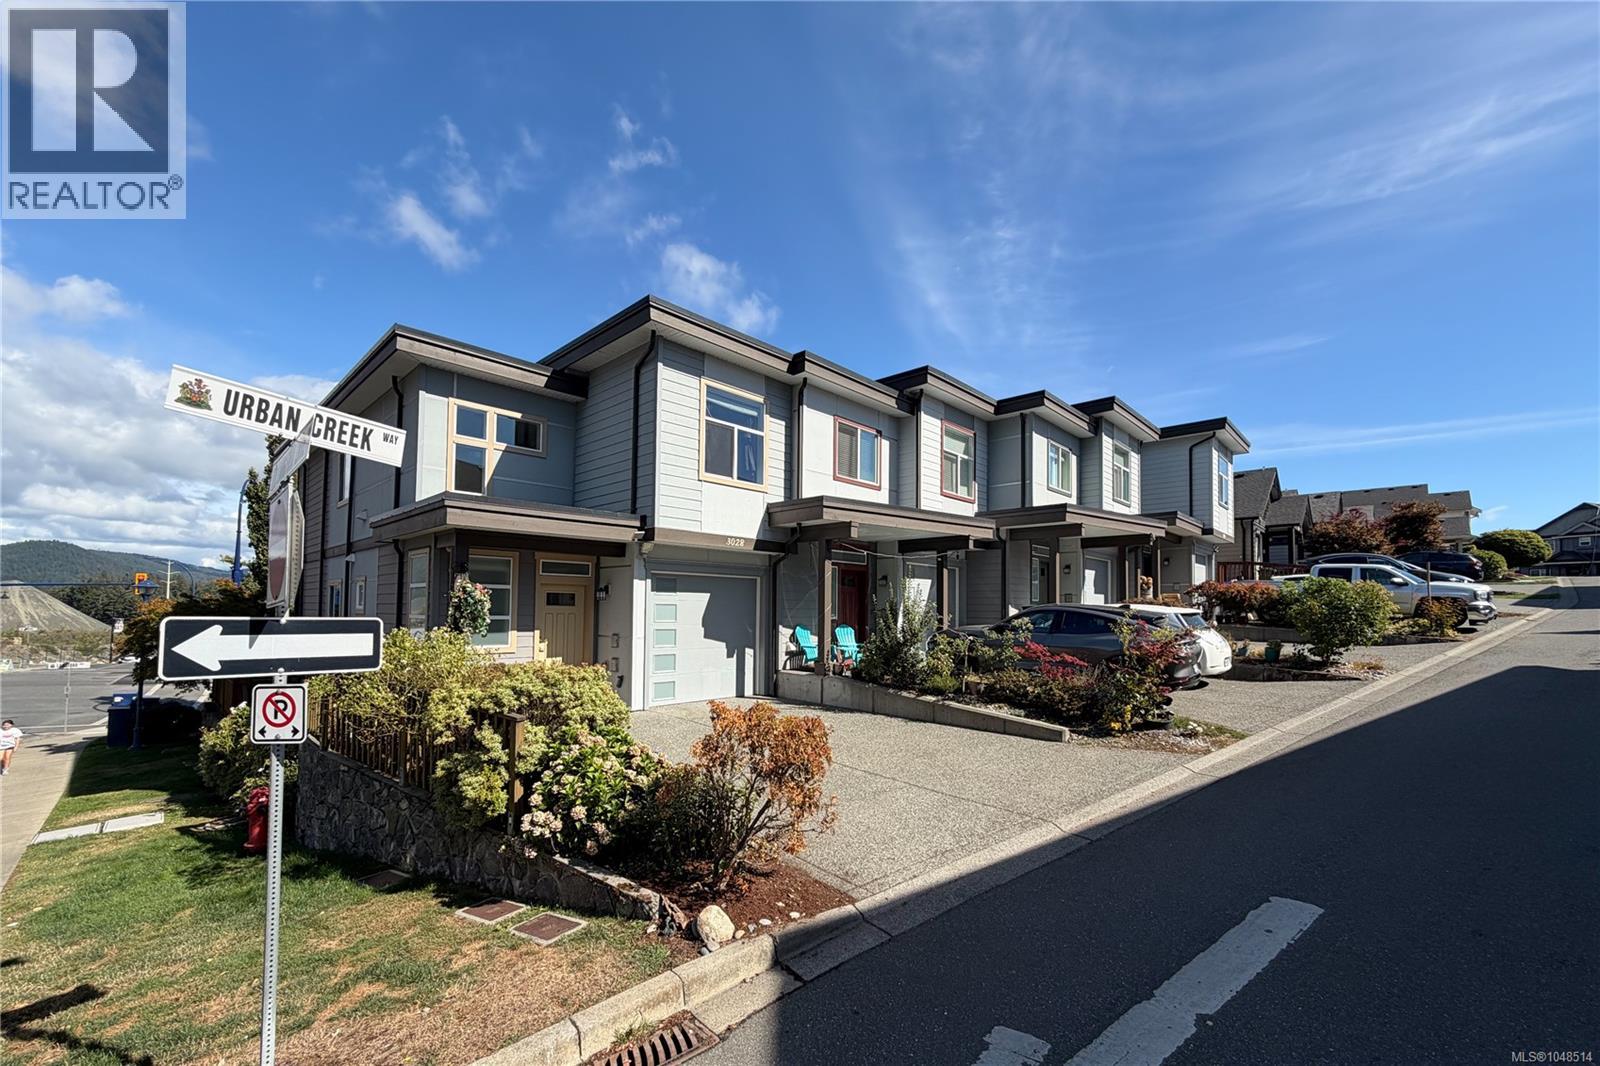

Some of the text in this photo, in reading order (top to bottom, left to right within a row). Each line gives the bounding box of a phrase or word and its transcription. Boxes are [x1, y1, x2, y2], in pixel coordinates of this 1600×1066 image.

[222, 388, 399, 452] URBAN CREEK WAY
[725, 537, 745, 547] 3028
[273, 699, 288, 720] P
